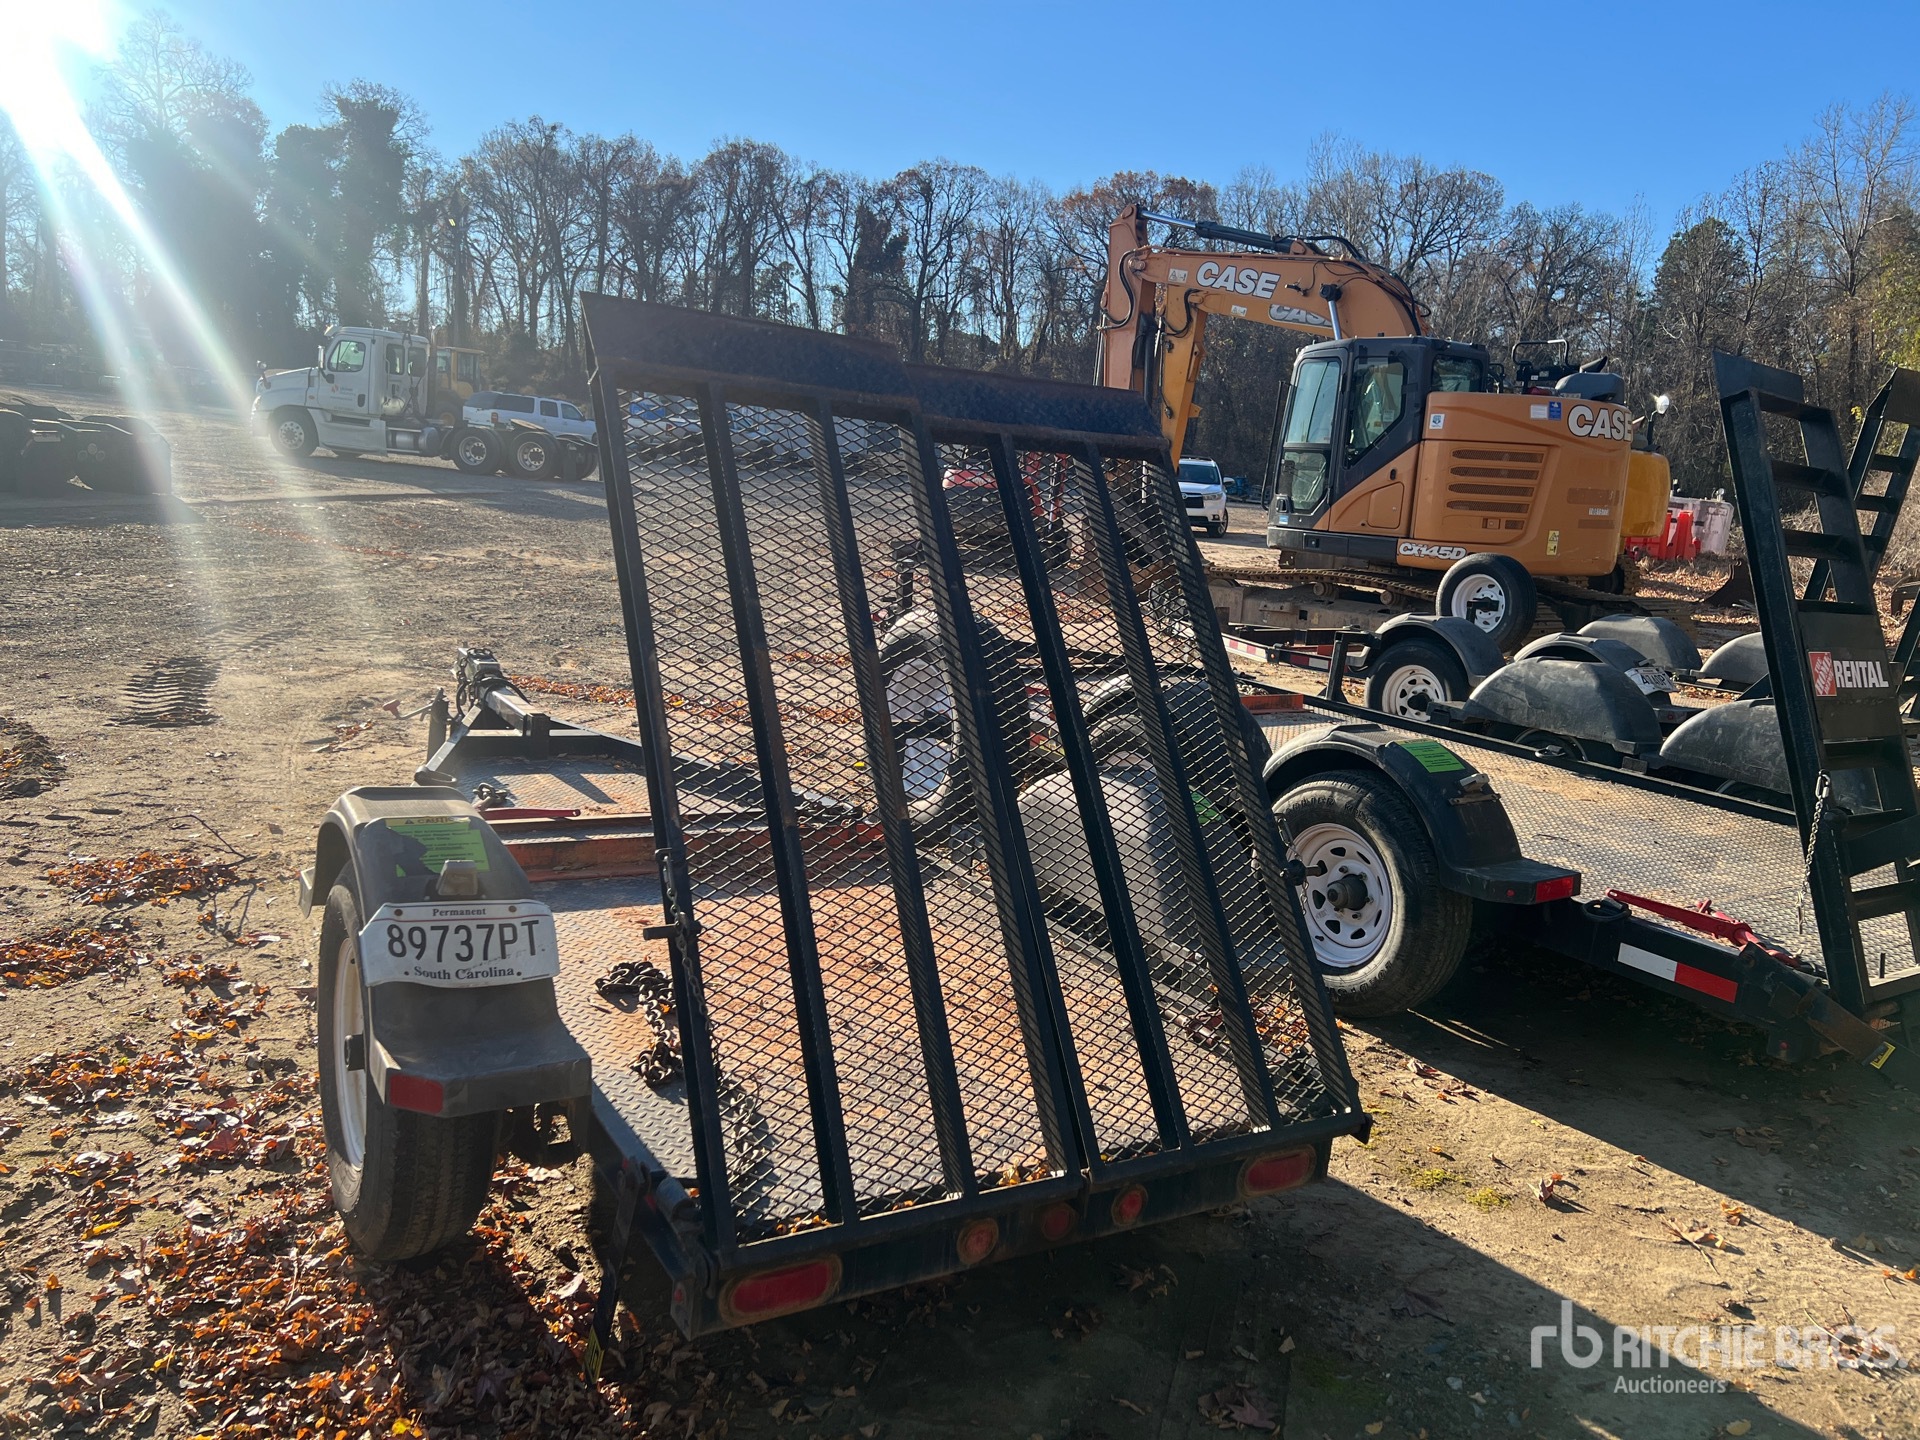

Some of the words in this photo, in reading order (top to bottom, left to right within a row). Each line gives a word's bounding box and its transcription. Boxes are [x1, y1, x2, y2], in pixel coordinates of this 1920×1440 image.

[1196, 261, 1281, 299] CASE
[1269, 303, 1333, 328] CAS
[1567, 404, 1633, 442] CASE
[1399, 542, 1467, 560] CX145D
[1833, 660, 1889, 688] RENTAL
[432, 908, 487, 917] Permanent
[386, 920, 540, 963] 89737PT
[414, 966, 450, 980] South
[455, 966, 514, 980] Carolina
